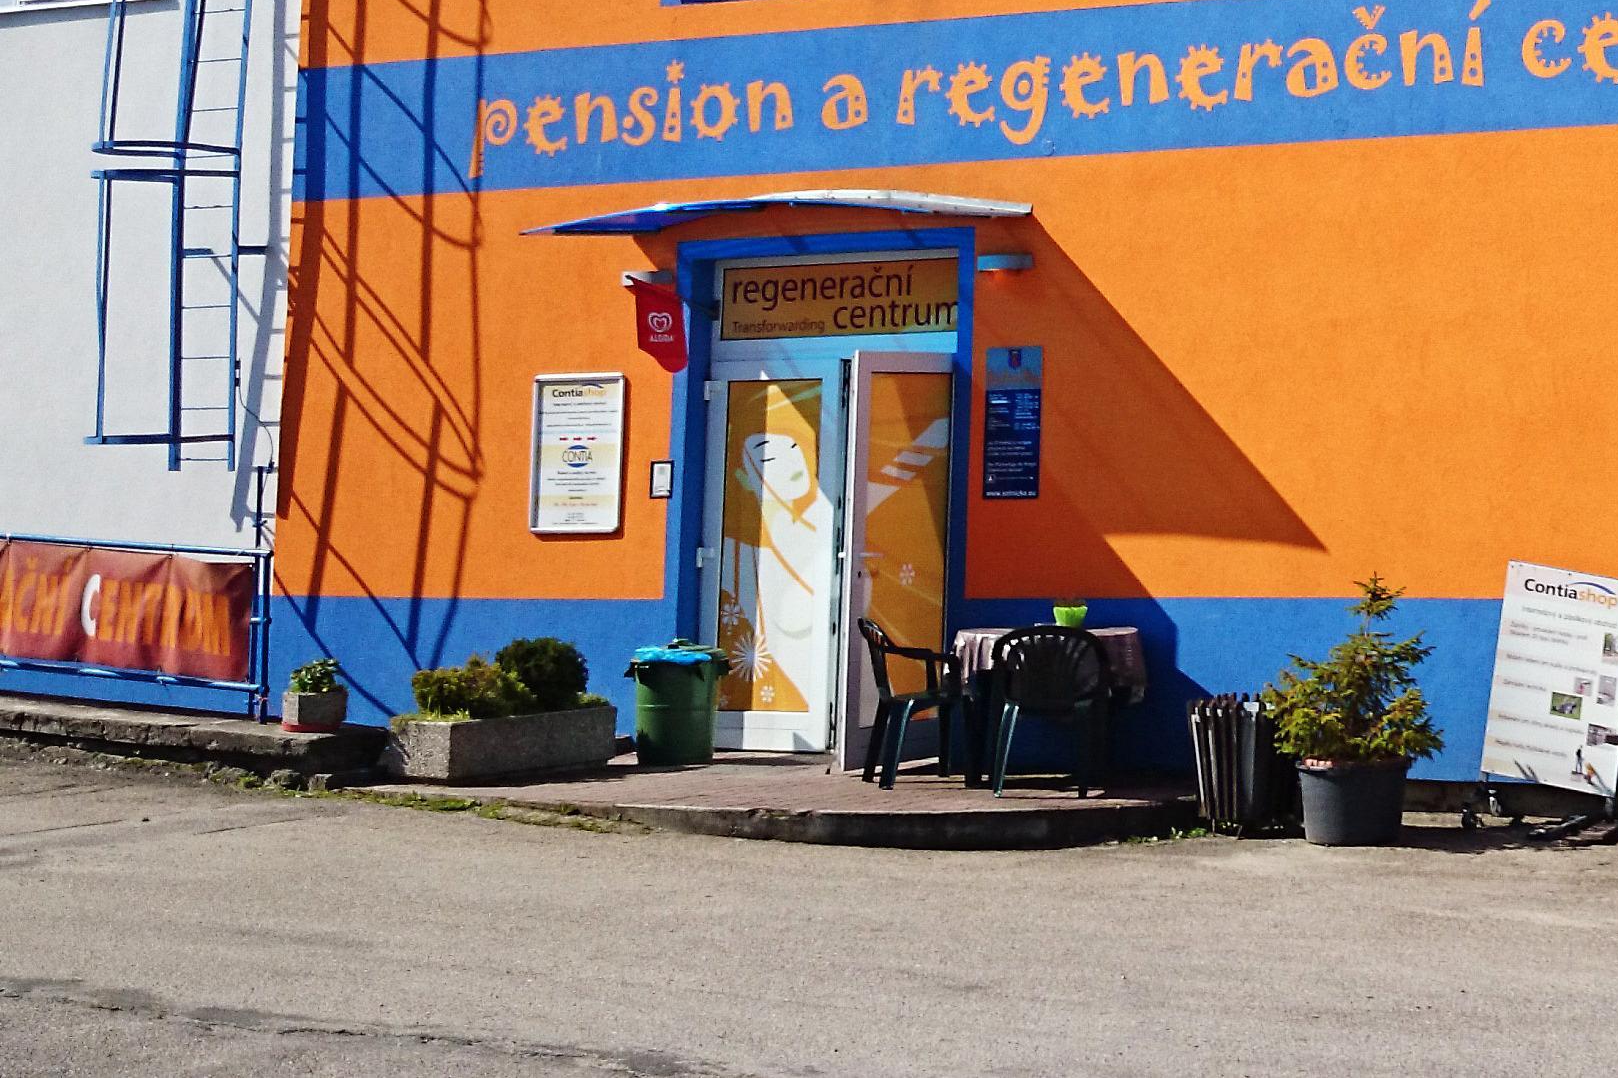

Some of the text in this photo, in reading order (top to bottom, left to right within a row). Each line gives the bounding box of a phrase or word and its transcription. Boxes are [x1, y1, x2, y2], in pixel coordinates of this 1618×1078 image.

[469, 59, 794, 178] pension
[821, 73, 868, 130] a
[732, 265, 913, 310] regenerační
[833, 300, 958, 329] centrum
[562, 450, 593, 463] CONTIA
[1524, 578, 1618, 609] Contiashop
